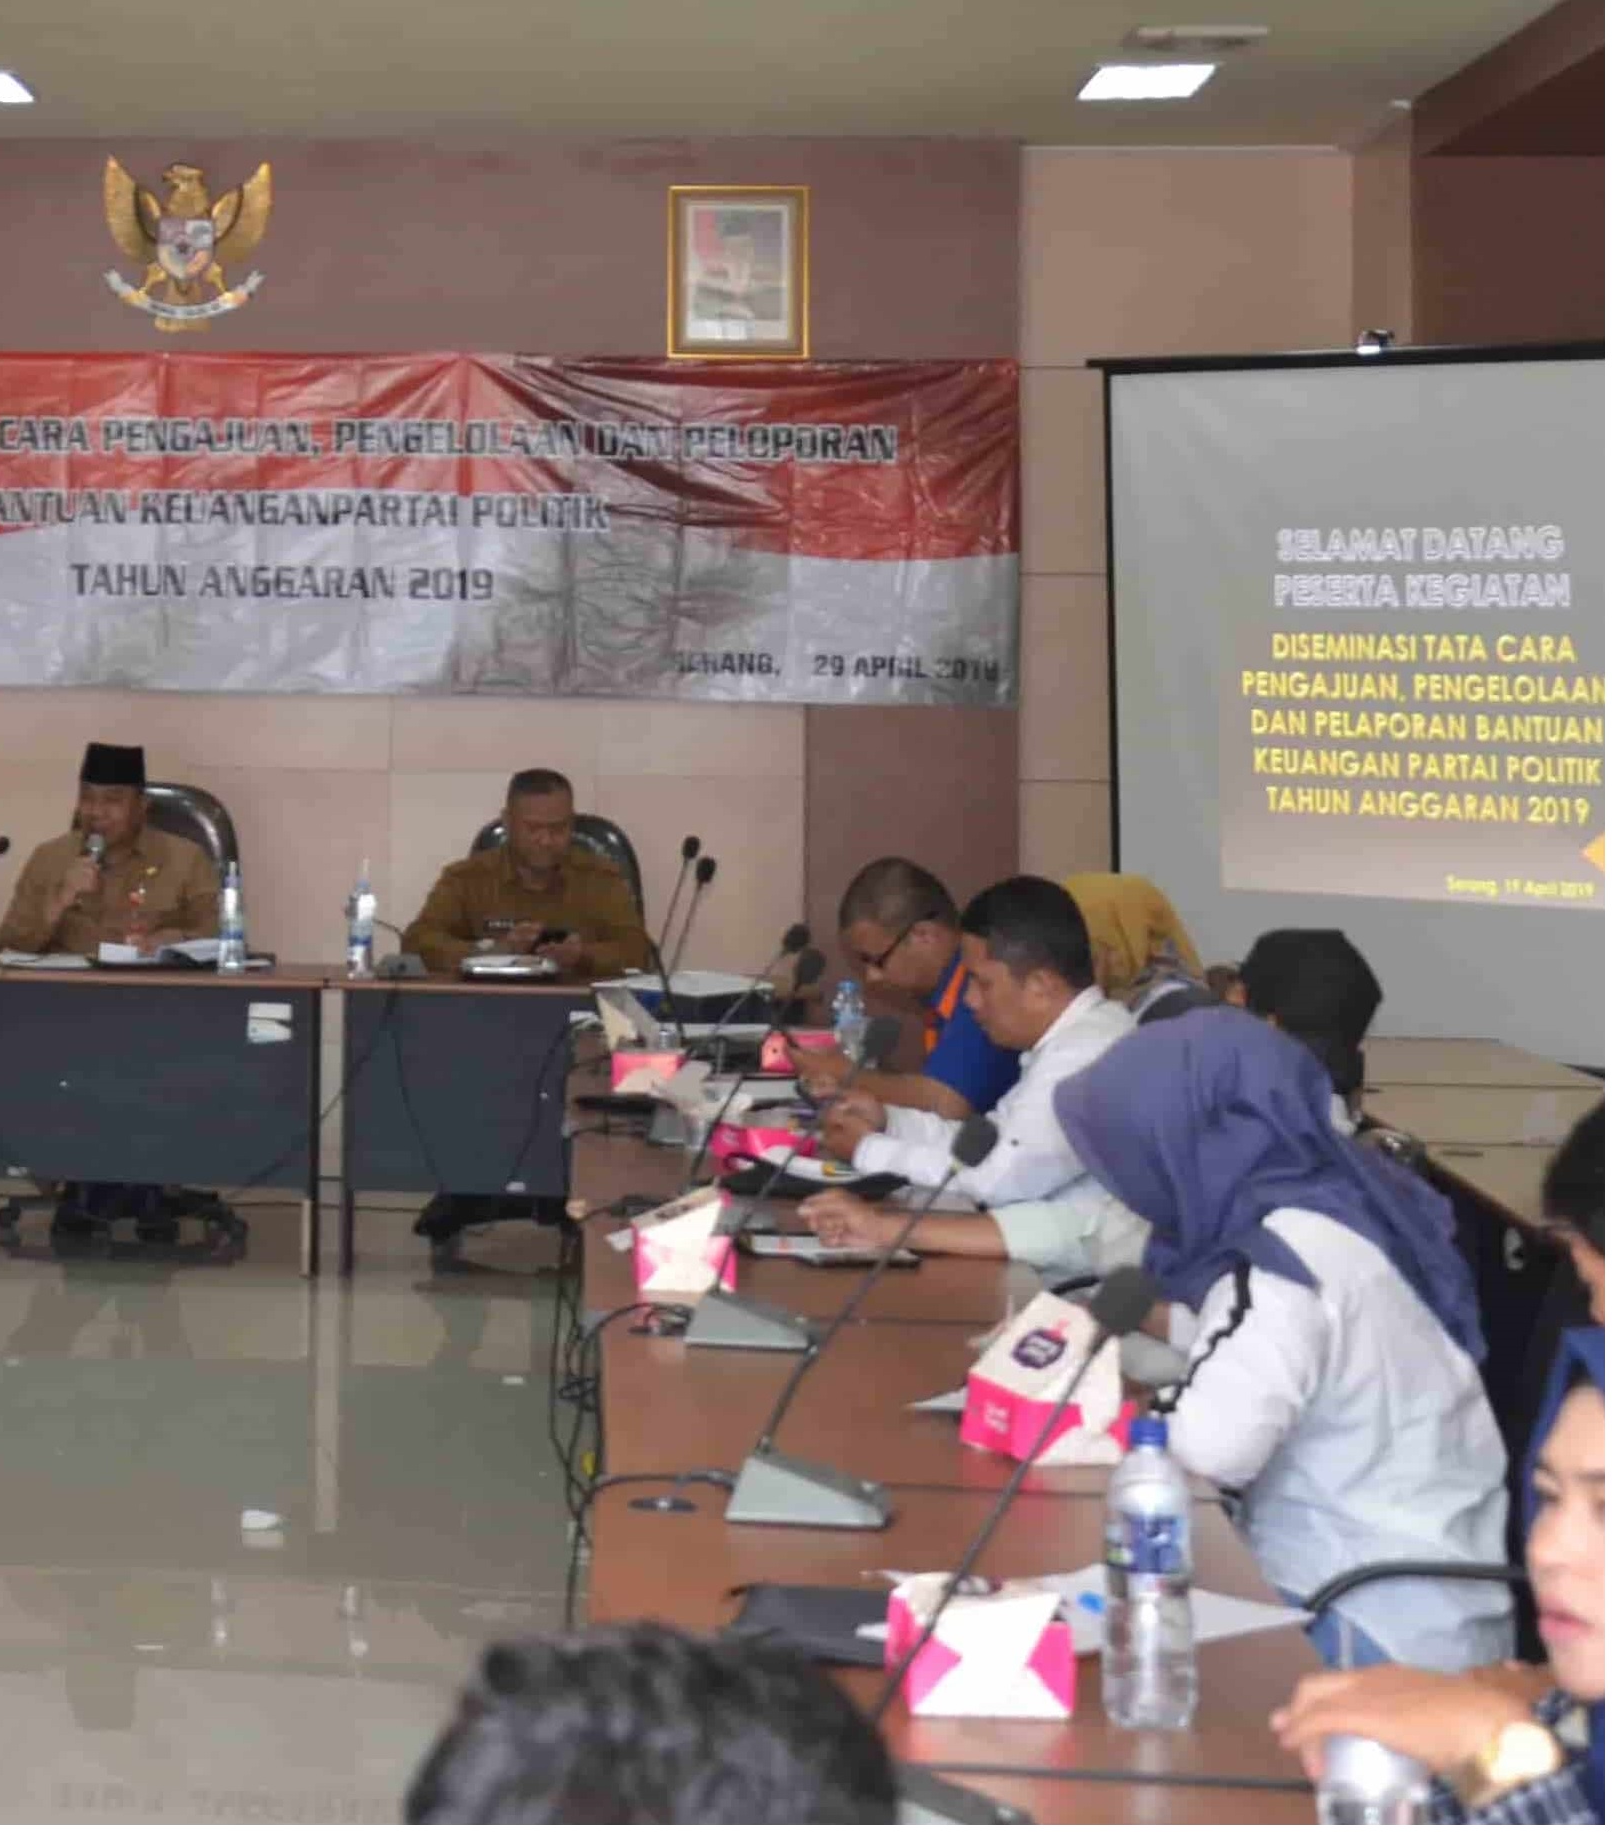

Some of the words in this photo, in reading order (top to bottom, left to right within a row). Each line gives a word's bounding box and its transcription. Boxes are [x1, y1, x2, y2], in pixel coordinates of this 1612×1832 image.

[102, 417, 323, 458] PENGAJUAN,
[334, 419, 581, 456] PENGELOLAAN
[595, 421, 674, 458] DAN
[683, 423, 897, 461] PELOPORAN
[470, 493, 609, 530] POLITIK
[1276, 526, 1418, 562] SELAMAT
[1422, 524, 1566, 561] DATANG
[70, 562, 187, 598] TAHUN
[198, 564, 395, 600] ANGGARAN
[407, 566, 494, 601] 2019
[1273, 573, 1401, 608] PESERTA
[1404, 573, 1571, 608] KEGIATAN
[812, 653, 845, 678] 29
[853, 654, 931, 680] APRIL
[1272, 632, 1418, 664] DISEMINASI
[1423, 633, 1488, 664] TATA
[1496, 633, 1579, 664] CARA
[1413, 672, 1606, 704] PENGELOLAAN
[1250, 708, 1308, 737] DAN
[1313, 710, 1468, 741] PELAPORAN
[1475, 713, 1604, 745] BANTUAN
[1253, 746, 1402, 779] KEUANGAN
[1407, 751, 1499, 782] PARTAI
[1505, 755, 1602, 786] POLITIK
[1265, 785, 1352, 816] TAHUN
[1358, 789, 1521, 823] ANGGARAN
[1526, 794, 1592, 826] 2019
